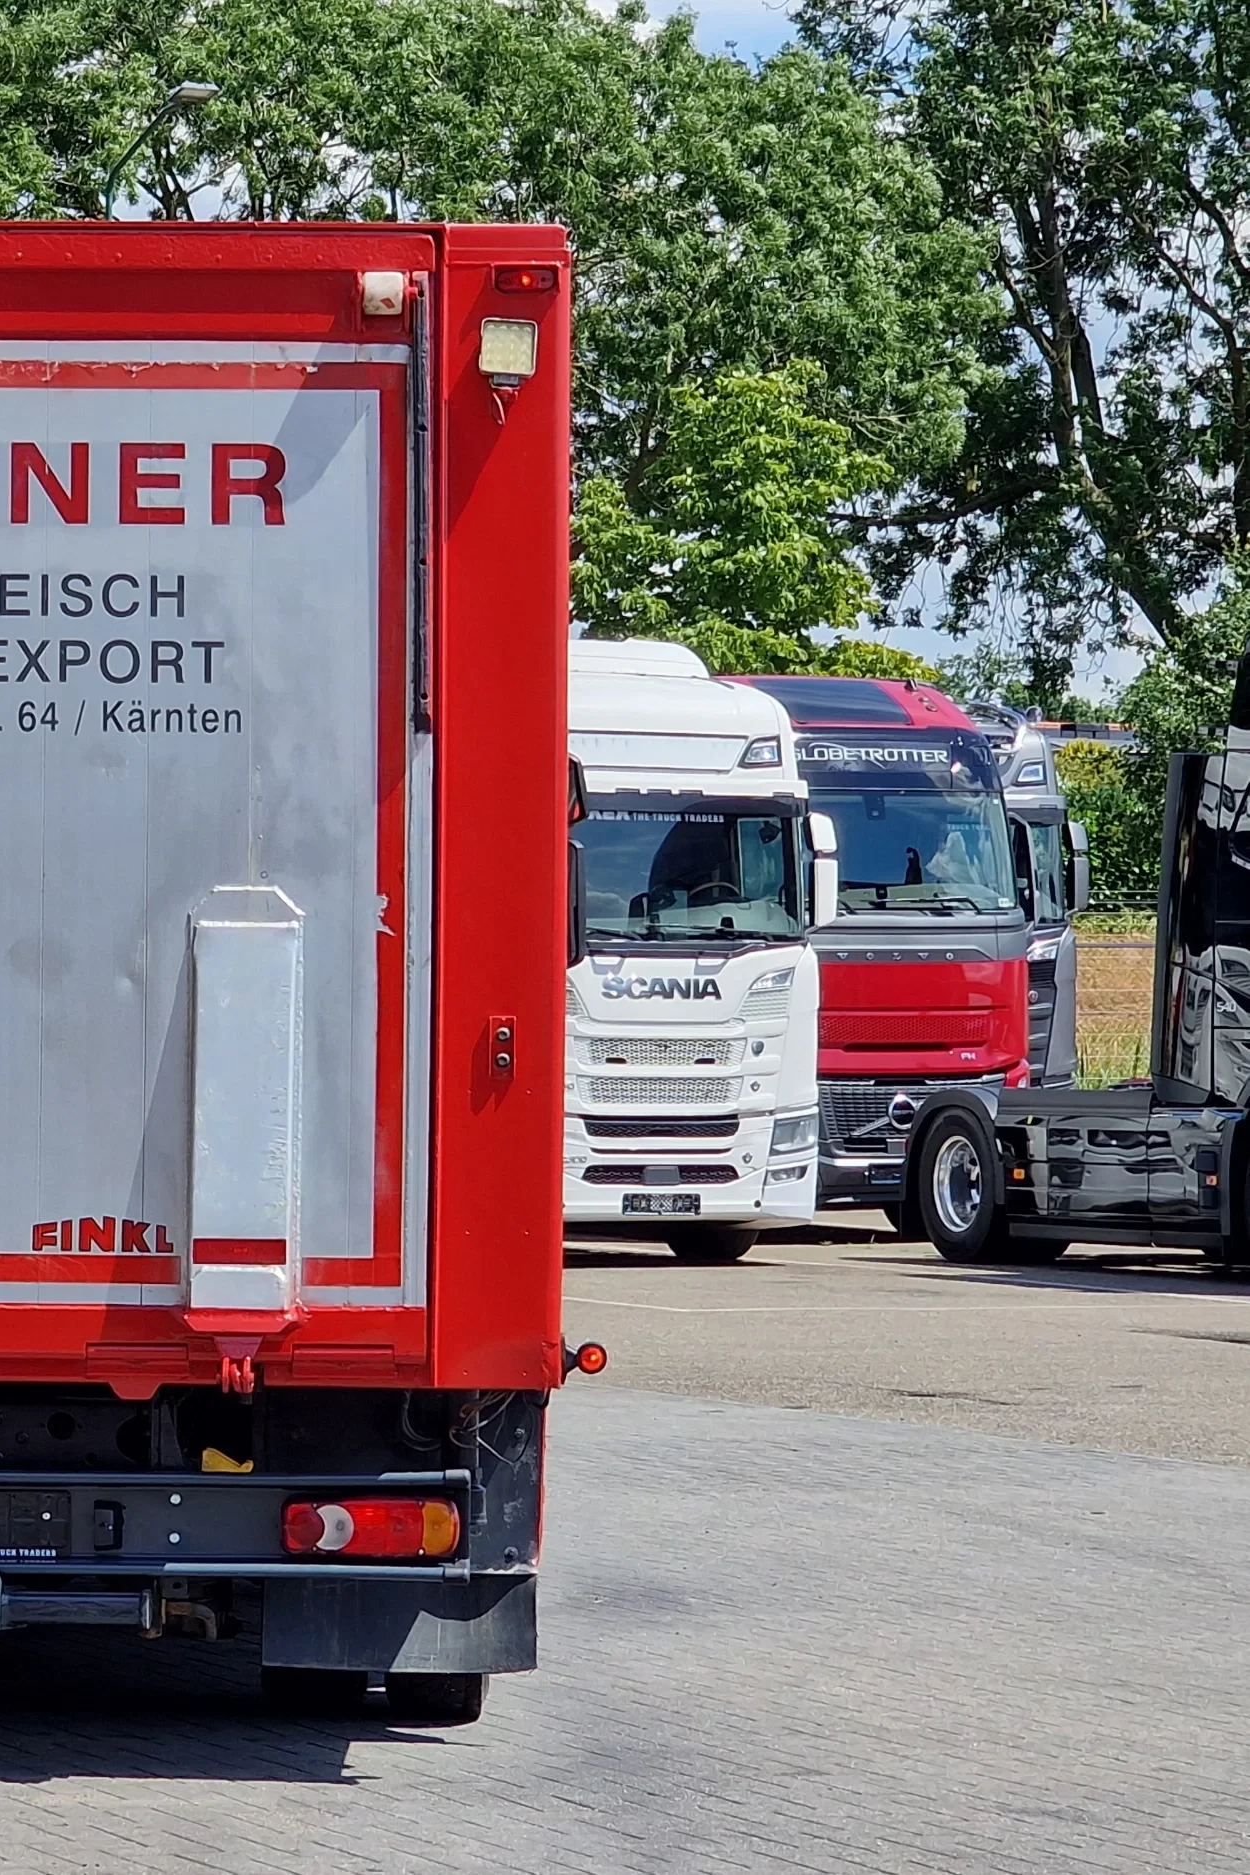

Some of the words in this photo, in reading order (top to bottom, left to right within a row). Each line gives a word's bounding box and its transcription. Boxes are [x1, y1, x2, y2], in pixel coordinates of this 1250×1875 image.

[18, 701, 59, 733] 64
[74, 700, 86, 736] /
[102, 700, 243, 734] Kärnten
[632, 812, 650, 822] THE
[652, 812, 682, 822] TRUCK
[684, 813, 725, 823] TRADERS
[836, 952, 954, 961] VOLVO
[601, 976, 723, 1000] SCANIA
[31, 1216, 175, 1253] FINKL
[19, 1548, 57, 1557] TRADERS
